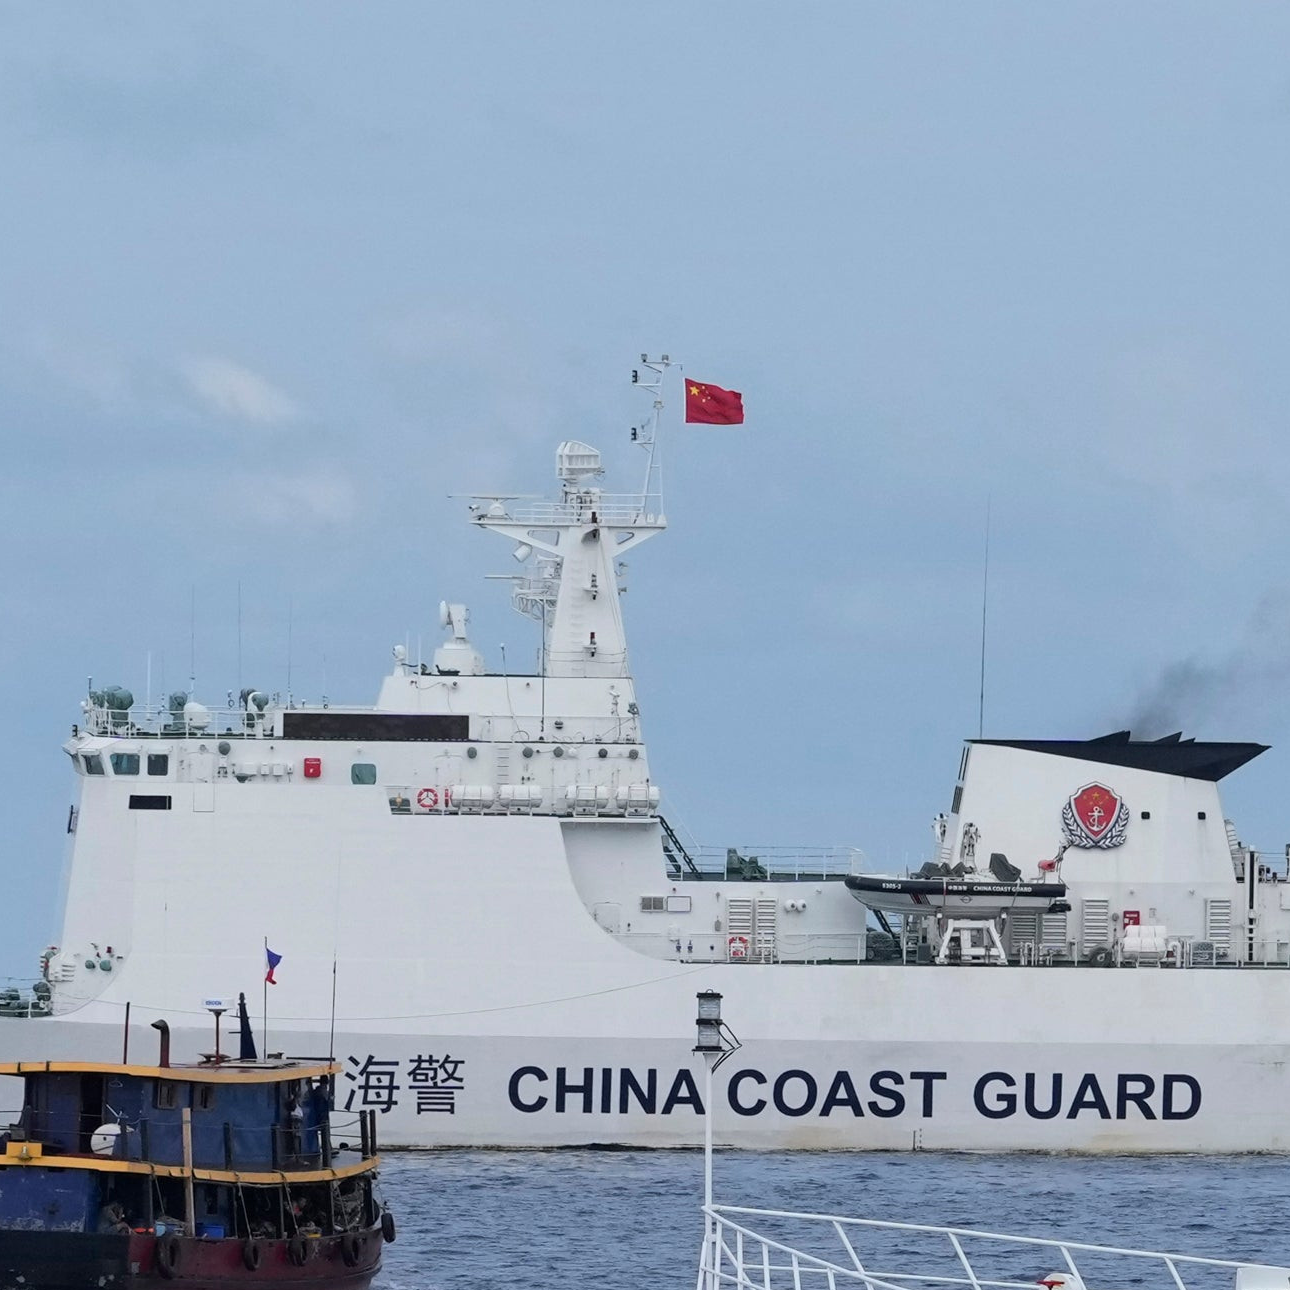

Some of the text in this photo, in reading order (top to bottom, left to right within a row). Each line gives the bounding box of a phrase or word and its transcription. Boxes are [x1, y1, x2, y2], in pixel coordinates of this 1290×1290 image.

[344, 1053, 1203, 1121] 海警 CHINA COAST GUARD
